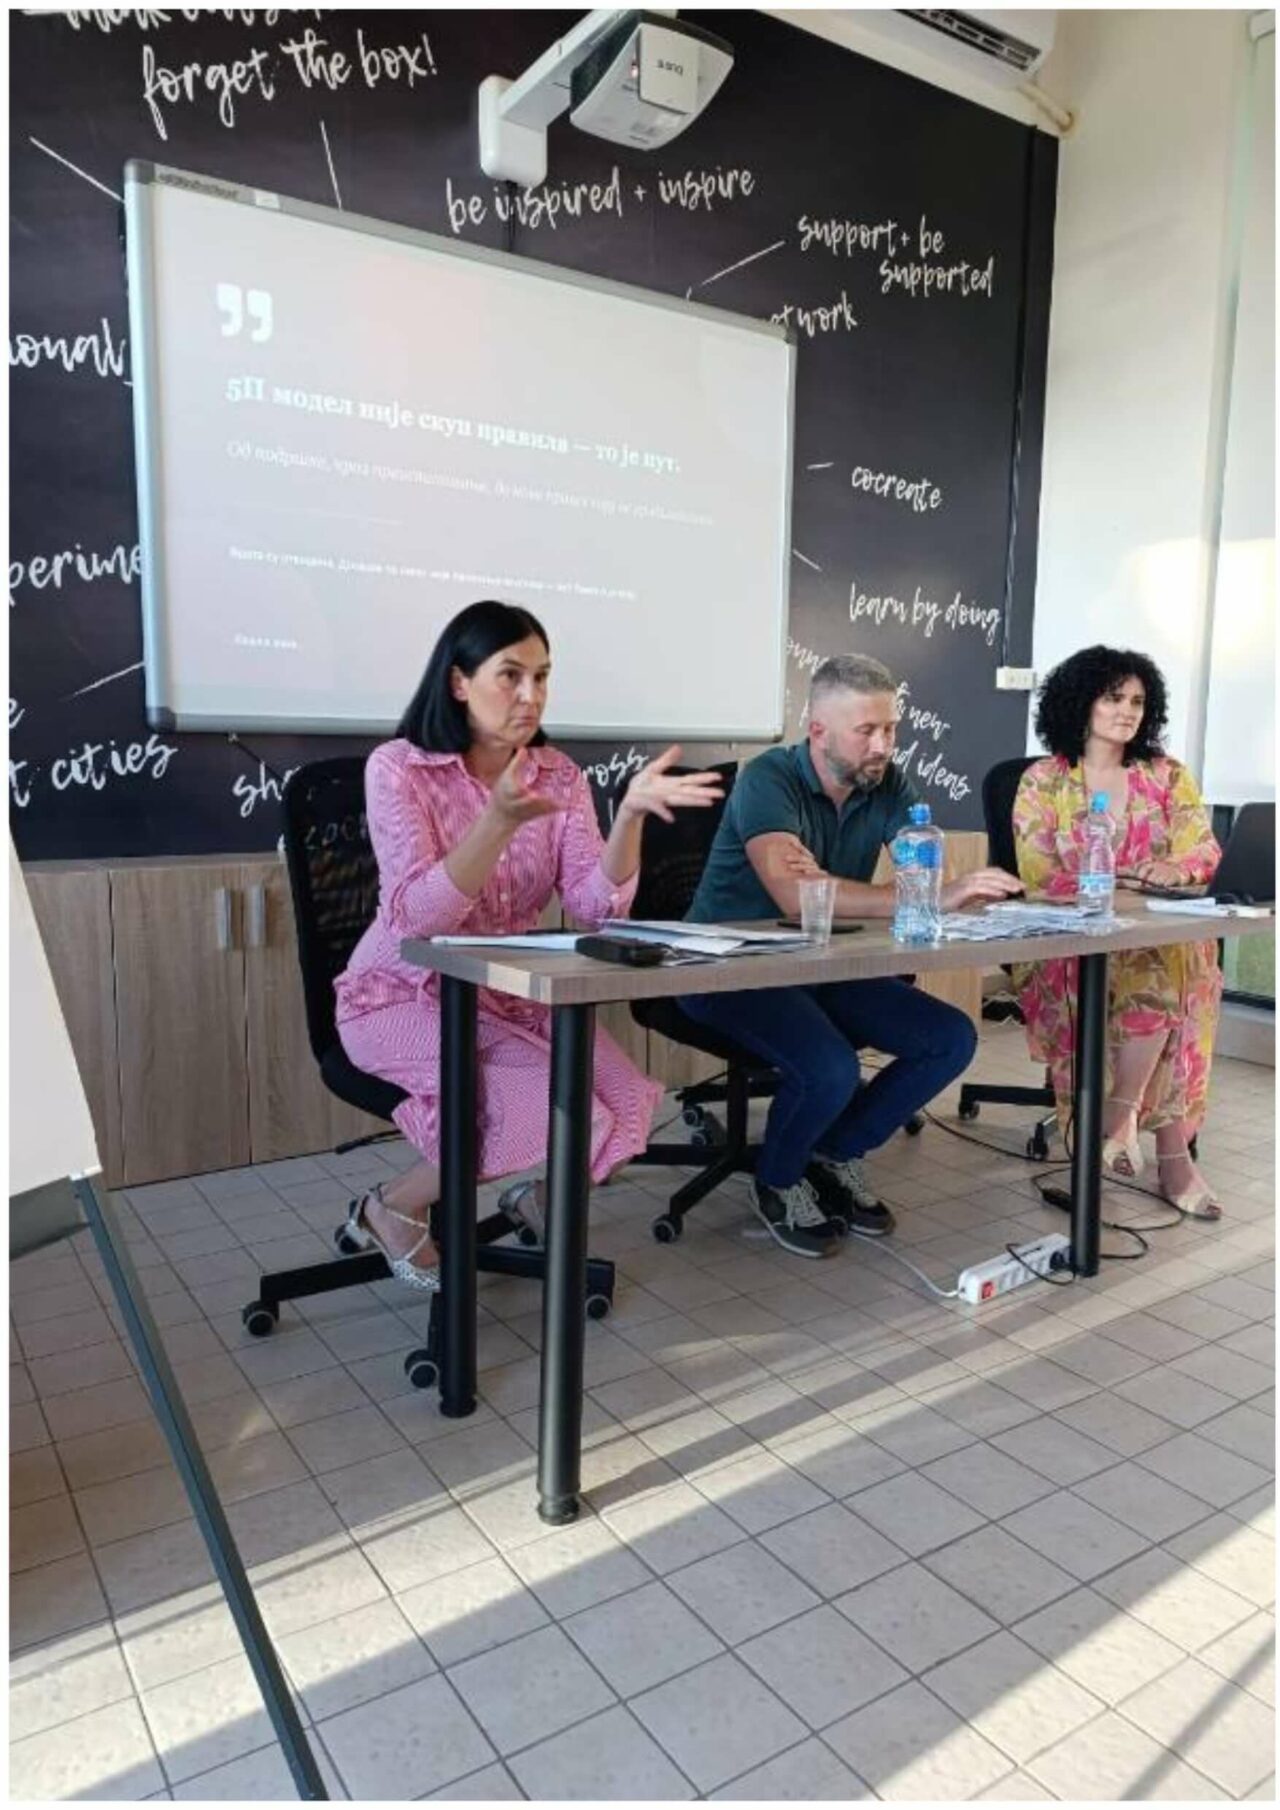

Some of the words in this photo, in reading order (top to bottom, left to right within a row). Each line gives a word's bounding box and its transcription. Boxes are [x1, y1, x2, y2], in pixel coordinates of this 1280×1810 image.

[143, 45, 275, 140] forget
[280, 29, 353, 90] the
[357, 29, 438, 88] box!
[446, 177, 487, 233] be
[494, 165, 622, 230] inspired
[658, 165, 756, 211] inspire
[797, 214, 898, 258] support
[919, 213, 946, 258] be
[879, 256, 994, 299] supported
[271, 386, 352, 416] модел
[358, 400, 415, 429] није
[418, 412, 472, 438] скуп
[477, 421, 570, 455] правила
[594, 443, 618, 462] то
[619, 443, 640, 468] је
[852, 466, 943, 512] cocreate
[849, 582, 909, 625] learn
[911, 586, 943, 638] by
[944, 591, 1001, 647] doing
[51, 733, 179, 790] cities
[917, 752, 972, 802] ideas
